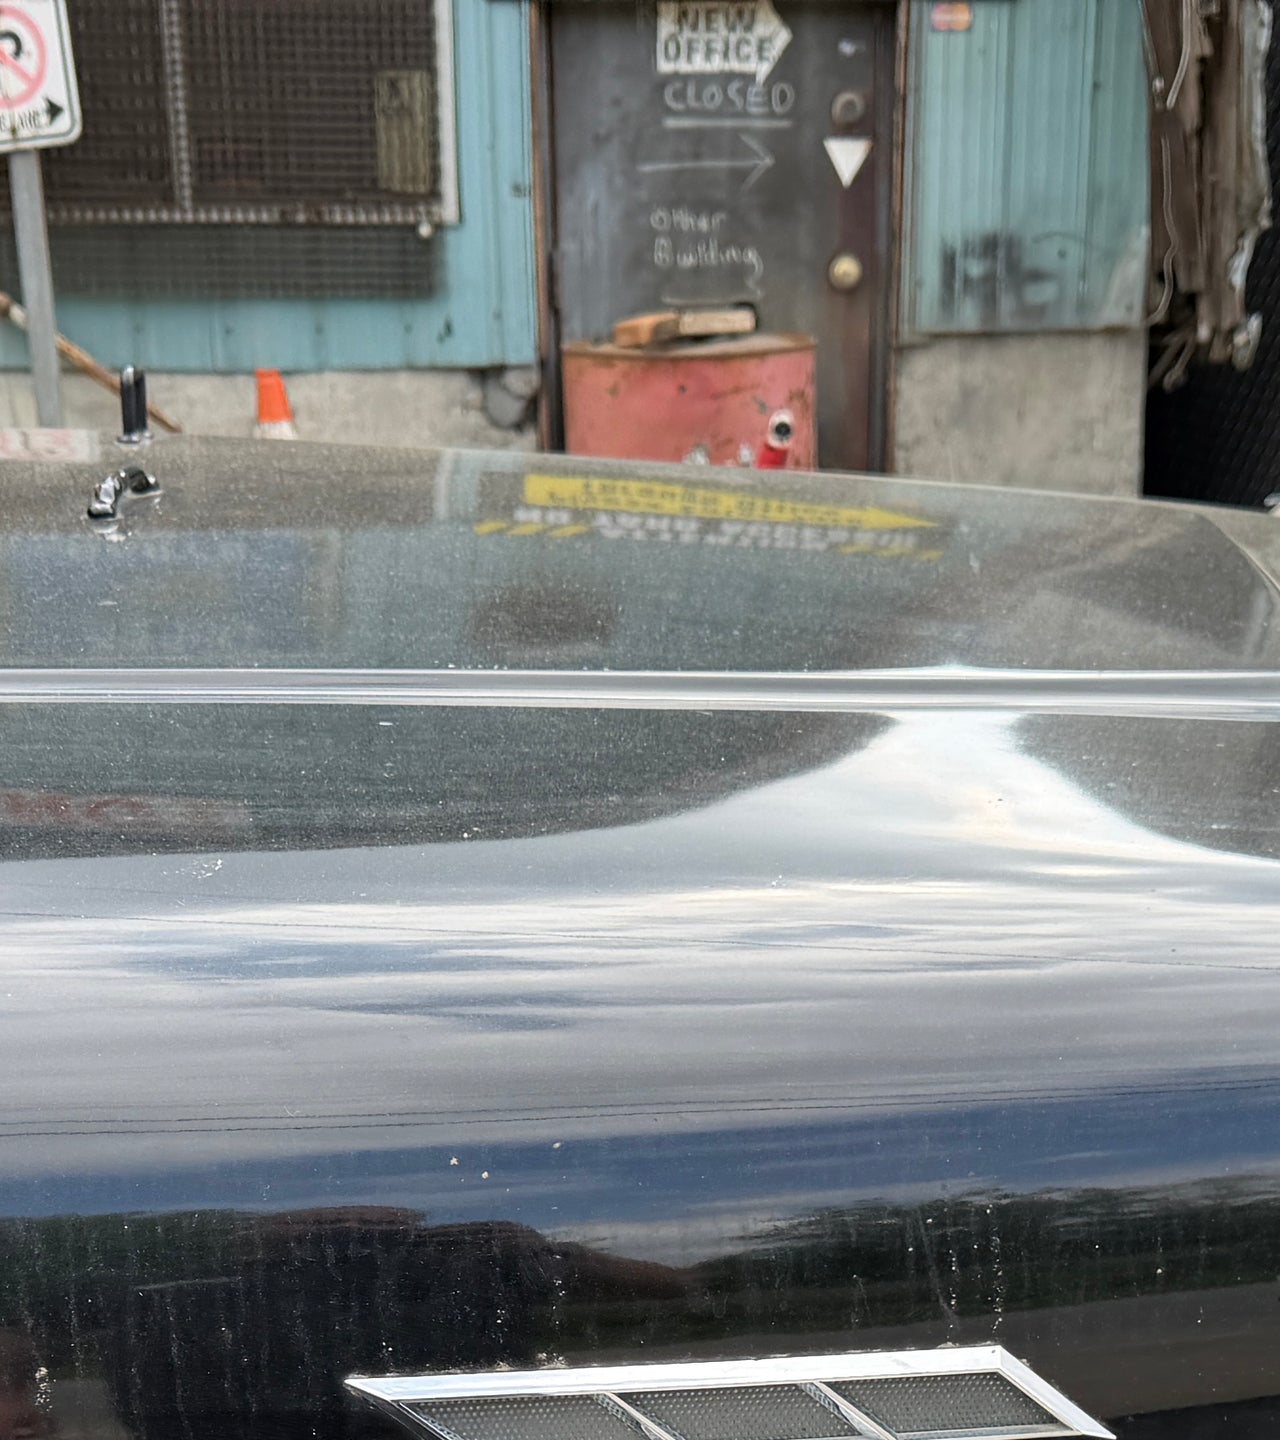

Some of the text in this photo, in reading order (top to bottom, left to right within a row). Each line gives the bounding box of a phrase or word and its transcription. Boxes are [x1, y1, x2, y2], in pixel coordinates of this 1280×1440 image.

[676, 4, 754, 33] NEW
[664, 35, 773, 63] OFFICE
[664, 79, 796, 115] CLOSED
